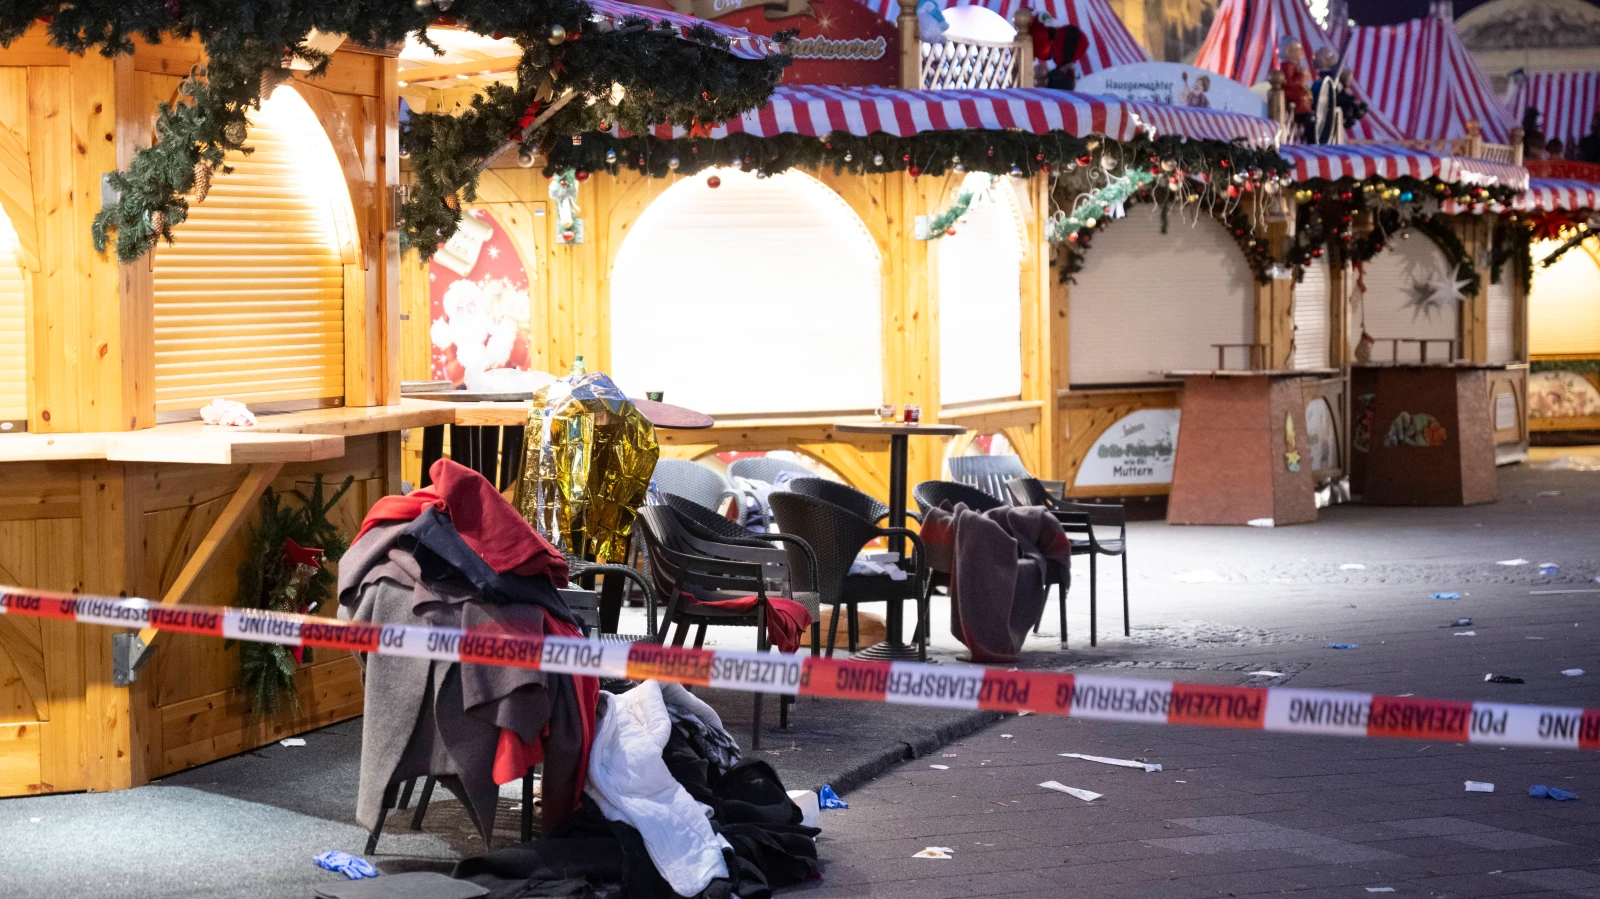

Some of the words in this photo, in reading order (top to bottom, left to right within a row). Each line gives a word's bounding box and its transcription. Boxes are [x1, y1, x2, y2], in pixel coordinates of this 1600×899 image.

[786, 35, 886, 59] ratwurst
[1113, 466, 1154, 477] Muttern
[238, 616, 406, 648] POLIZEIABSPERRUNG
[427, 632, 602, 668] POLIZEIABSPERRUNG
[628, 649, 813, 688] POLIZEIABSPERRUNG
[837, 667, 1031, 704] POLIZEIABSPERRUNG
[1056, 683, 1262, 720] POLIZEIABSPERRUNG
[1289, 700, 1508, 733] POLIZEIABSPERRUNG
